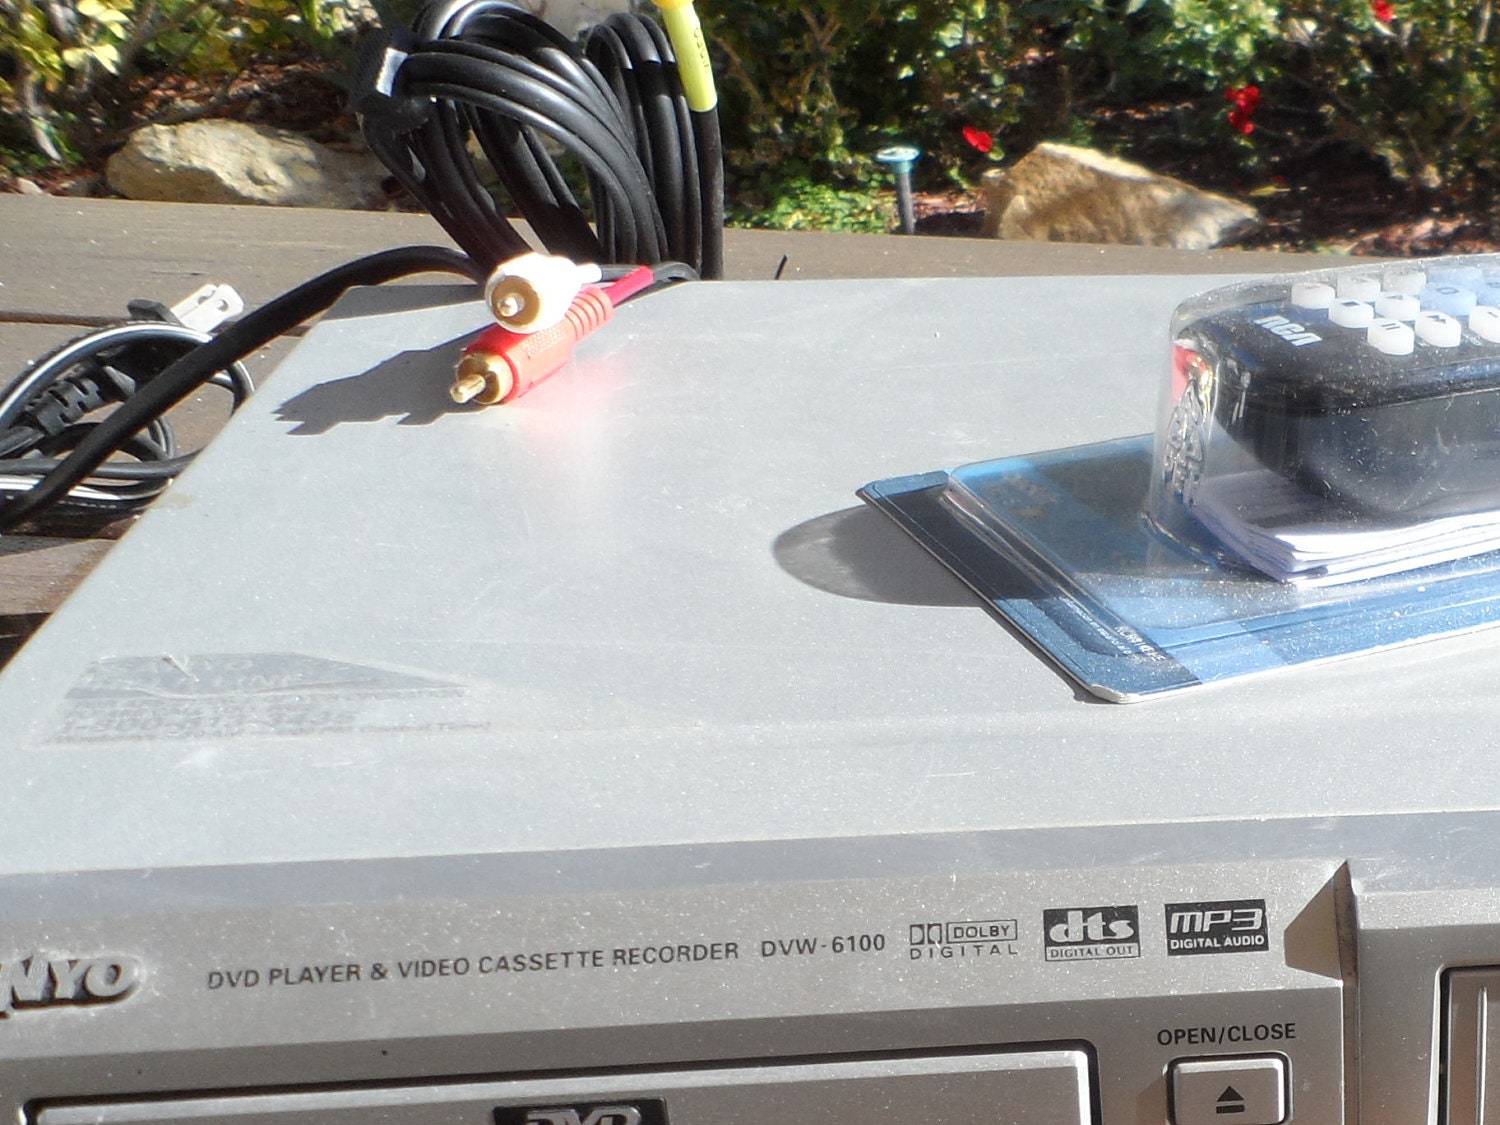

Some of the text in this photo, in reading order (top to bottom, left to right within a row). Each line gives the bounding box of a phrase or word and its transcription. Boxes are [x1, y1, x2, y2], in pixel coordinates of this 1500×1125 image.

[1253, 314, 1323, 348] RCA
[952, 923, 1011, 941] DOLBY
[1049, 909, 1136, 943] dts
[1169, 906, 1265, 934] MP3
[761, 933, 886, 959] DVW-6100
[910, 943, 1019, 959] DIGITAL
[1049, 943, 1136, 959] DIGITAL OUT
[1170, 934, 1266, 950] DIGITAL AUDIO
[208, 940, 738, 990] DVD PLAYER & VIDEO CASSETTE RECORDER
[1156, 1022, 1297, 1047] OPEN/CLOSE
